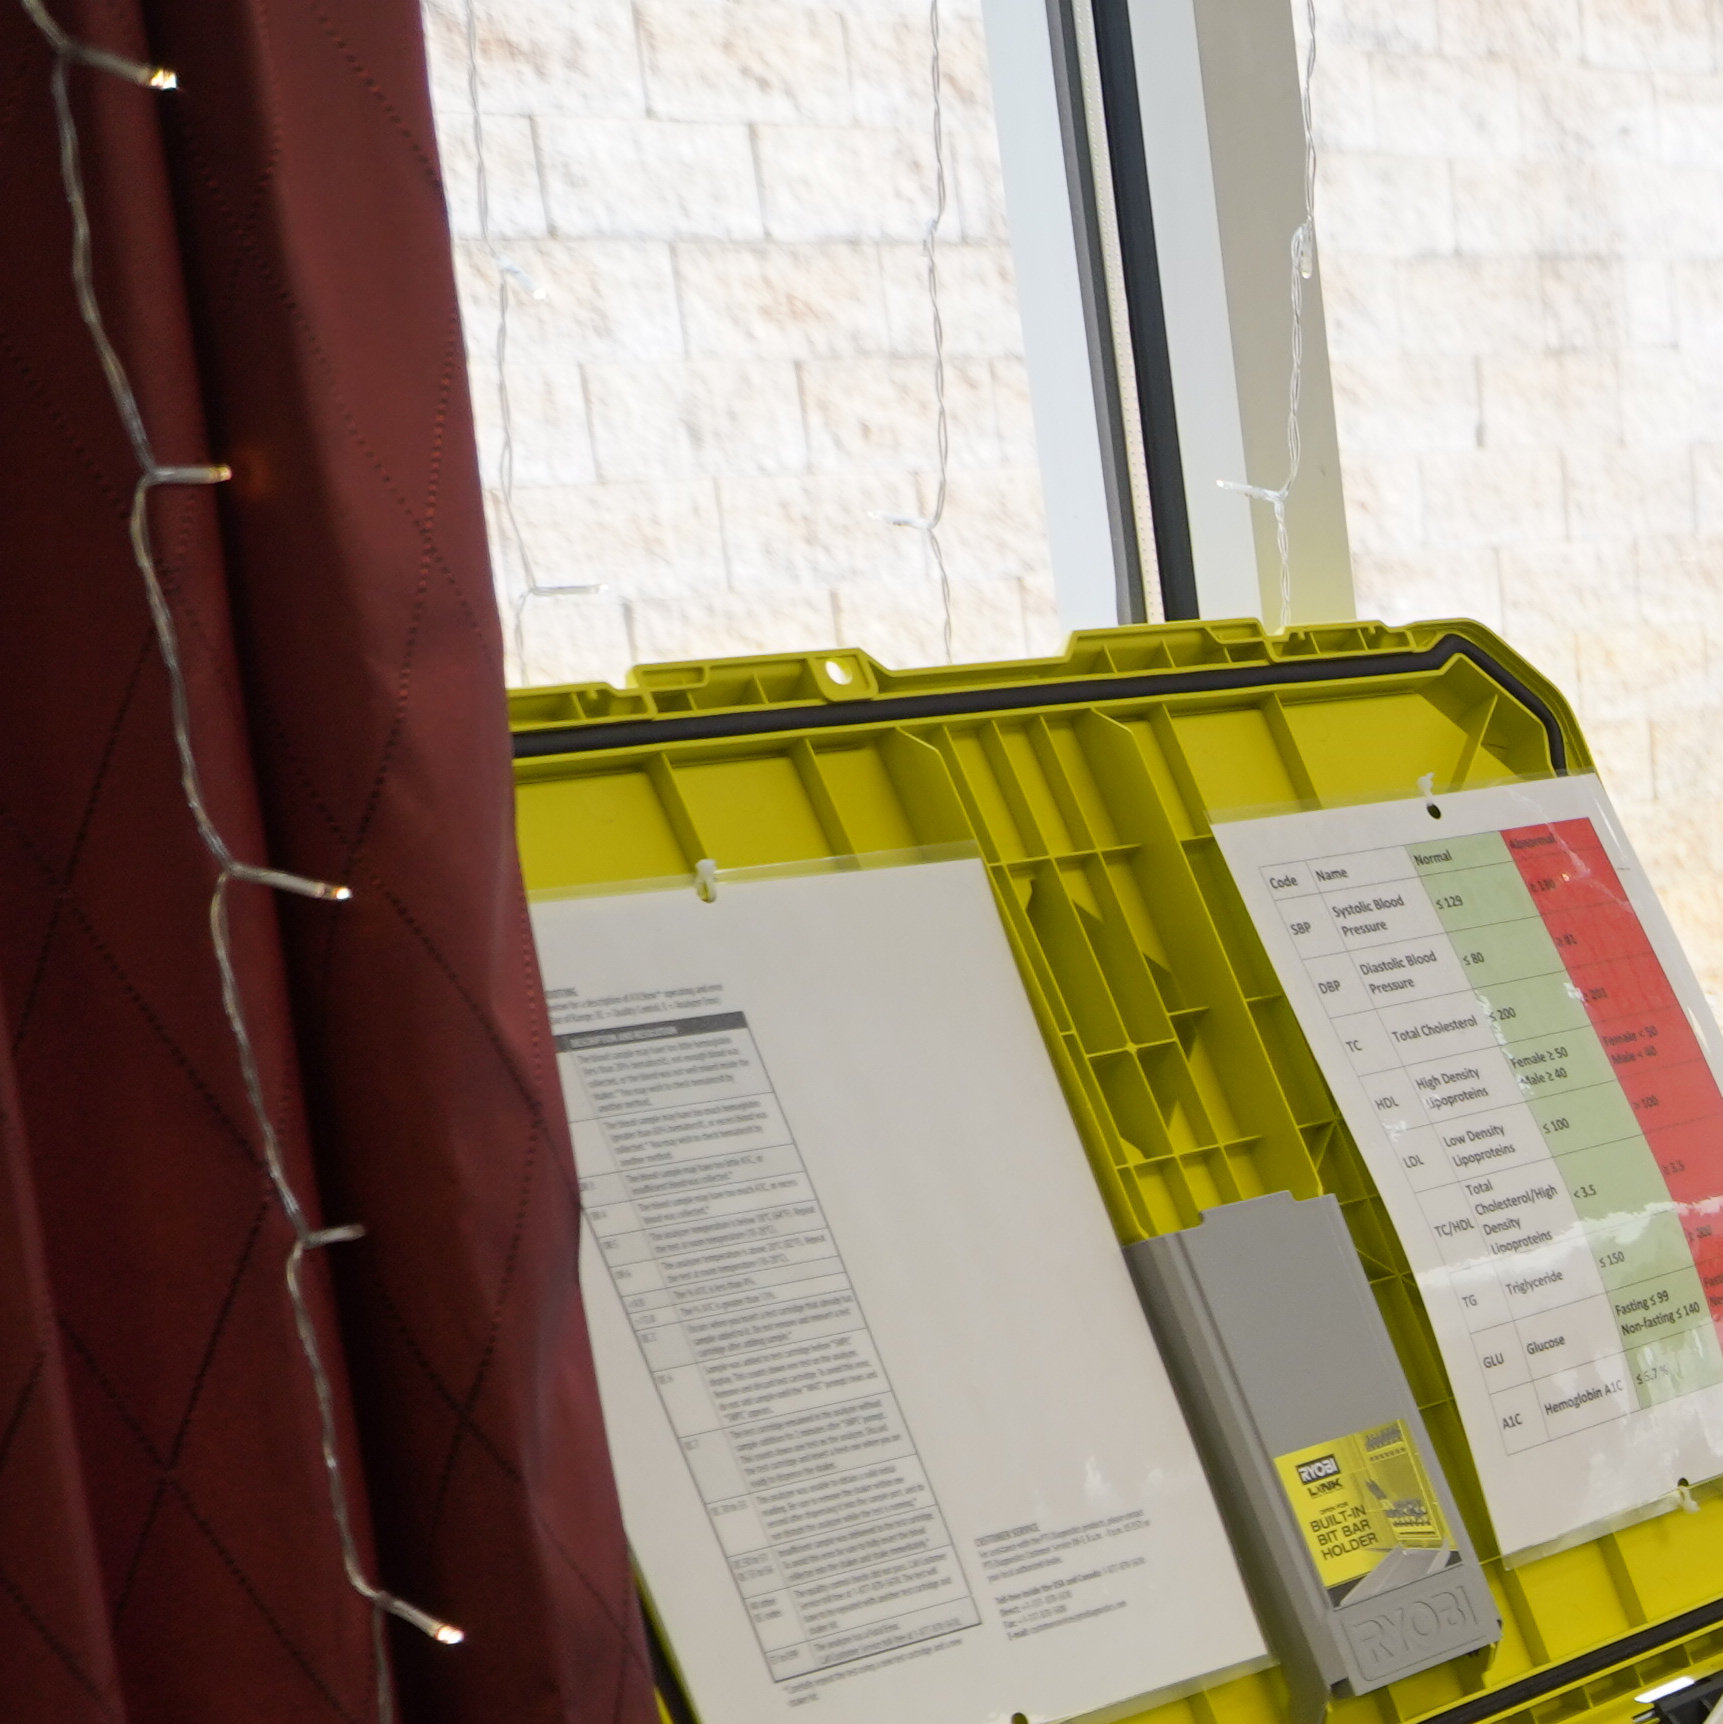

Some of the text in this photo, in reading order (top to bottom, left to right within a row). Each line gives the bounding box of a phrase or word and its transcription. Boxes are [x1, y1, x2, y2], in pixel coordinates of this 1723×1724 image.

[1414, 850, 1453, 867] Normal
[1269, 875, 1298, 890] Code
[1315, 868, 1348, 882] Name
[1332, 895, 1405, 919] Systolic Blood
[1446, 895, 1464, 909] 129
[1290, 921, 1312, 936] SBP
[1341, 920, 1387, 937] Pressure
[1359, 951, 1437, 976] Diastolic Blood
[1470, 951, 1485, 965] 80
[1317, 980, 1341, 995] DBP
[1369, 977, 1415, 995] Pressure
[1497, 1006, 1517, 1021] 200
[1392, 1015, 1478, 1043] Total Cholesterol
[1345, 1040, 1363, 1053] TC
[1510, 1052, 1548, 1070] Female
[1554, 1046, 1569, 1059] 50
[1415, 1068, 1480, 1091] High Density
[1554, 1067, 1568, 1080] 40
[1375, 1096, 1399, 1111] HDL
[1425, 1087, 1489, 1111] Lipoproteins
[1551, 1118, 1570, 1132] 100
[1443, 1124, 1505, 1148] Low Density
[1403, 1155, 1425, 1169] LDL
[1452, 1144, 1516, 1168] Lipoproteins
[1465, 1180, 1493, 1197] Total
[1581, 1184, 1597, 1198] 3.5
[1474, 1184, 1558, 1216] Cholesterol/High
[1433, 1217, 1475, 1238] TC/HDL
[1483, 1217, 1521, 1236] Density
[1490, 1230, 1553, 1256] Lipoproteins
[1607, 1251, 1625, 1266] 150
[1505, 1270, 1564, 1296] Triglyceride
[1461, 1294, 1478, 1308] TG
[1615, 1297, 1650, 1316] Fasting
[1657, 1290, 1670, 1303] 99
[1620, 1310, 1676, 1337] Non-fasting
[1683, 1302, 1700, 1317] 140
[1526, 1335, 1566, 1355] Glucose
[1483, 1353, 1504, 1369] GLU
[1544, 1389, 1603, 1416] Hemoglobin
[1502, 1413, 1524, 1430] A1C
[1297, 1456, 1340, 1483] RYOBI
[1310, 1504, 1367, 1533] BUILT-IN
[1316, 1519, 1372, 1546] BIT BAR
[1321, 1532, 1379, 1561] HOLDER
[1352, 1585, 1478, 1664] RYOBI
